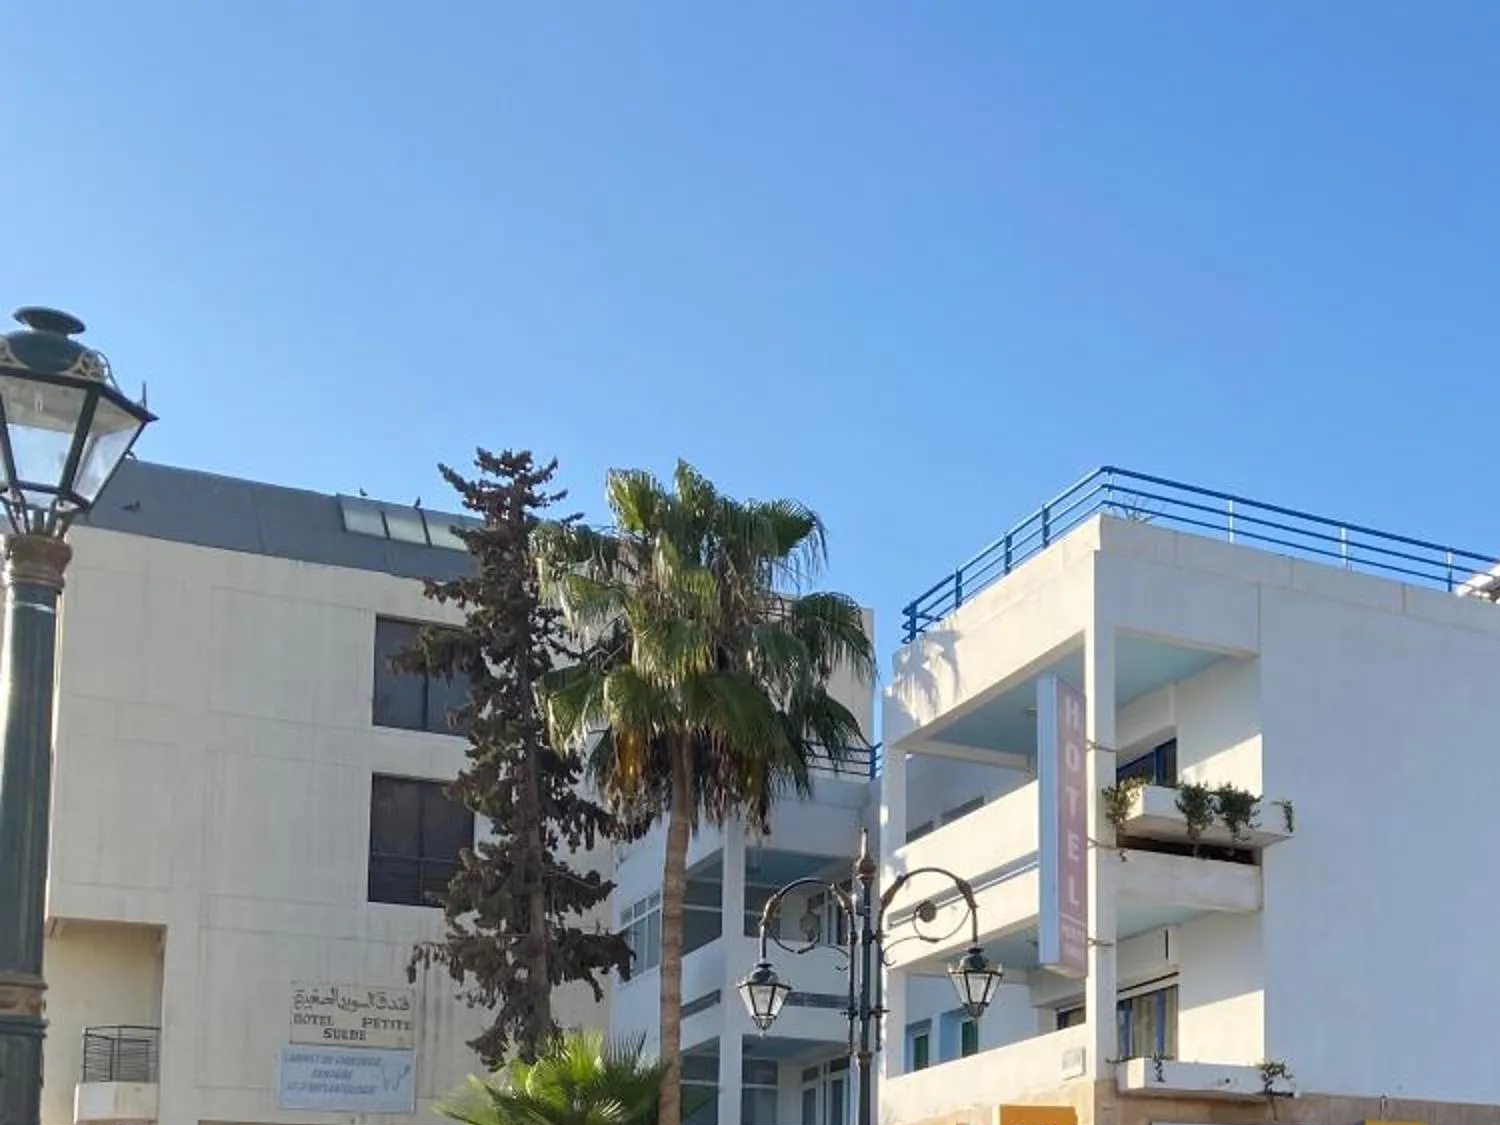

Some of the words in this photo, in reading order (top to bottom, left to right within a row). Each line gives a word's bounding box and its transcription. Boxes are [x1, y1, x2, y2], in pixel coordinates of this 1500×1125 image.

[1064, 694, 1081, 908] HOTEL
[293, 1013, 334, 1026] HOTEL
[361, 1016, 414, 1031] PETITE
[322, 1027, 366, 1040] SUEDE
